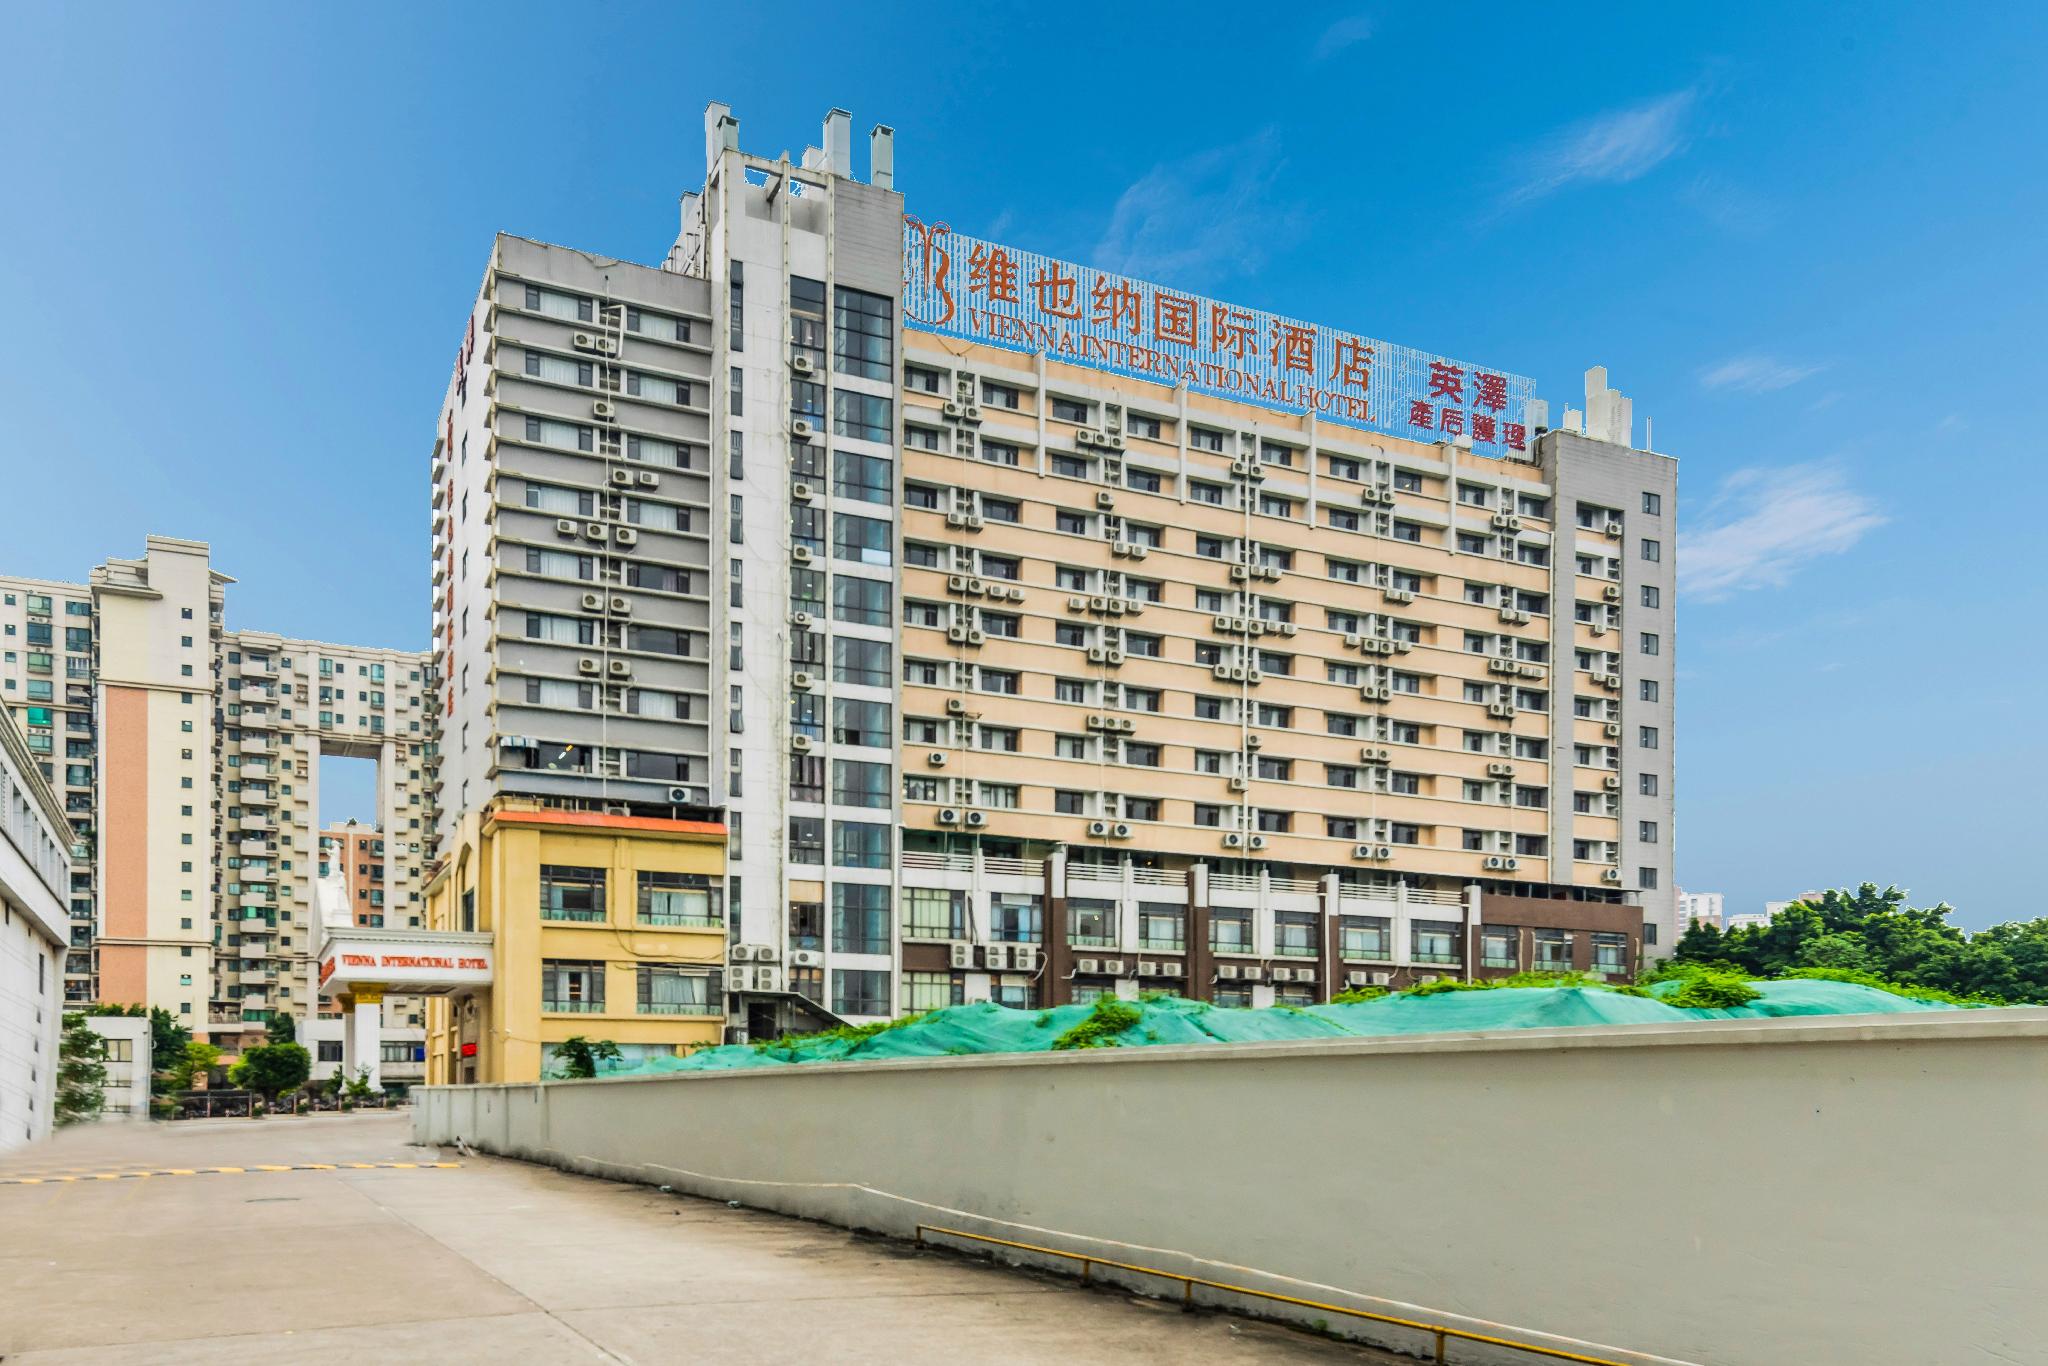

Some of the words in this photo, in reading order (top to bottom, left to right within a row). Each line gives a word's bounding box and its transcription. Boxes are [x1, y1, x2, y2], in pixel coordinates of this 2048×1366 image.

[967, 243, 1375, 392] 维也纳国际酒店
[968, 307, 1077, 355] VIENNA
[1080, 333, 1294, 404] INTERNATIONAL
[1297, 384, 1376, 423] HOTEL
[342, 954, 376, 967] VIENNA
[381, 955, 454, 969] INTERNATIONAL
[458, 957, 488, 970] HOTEL
